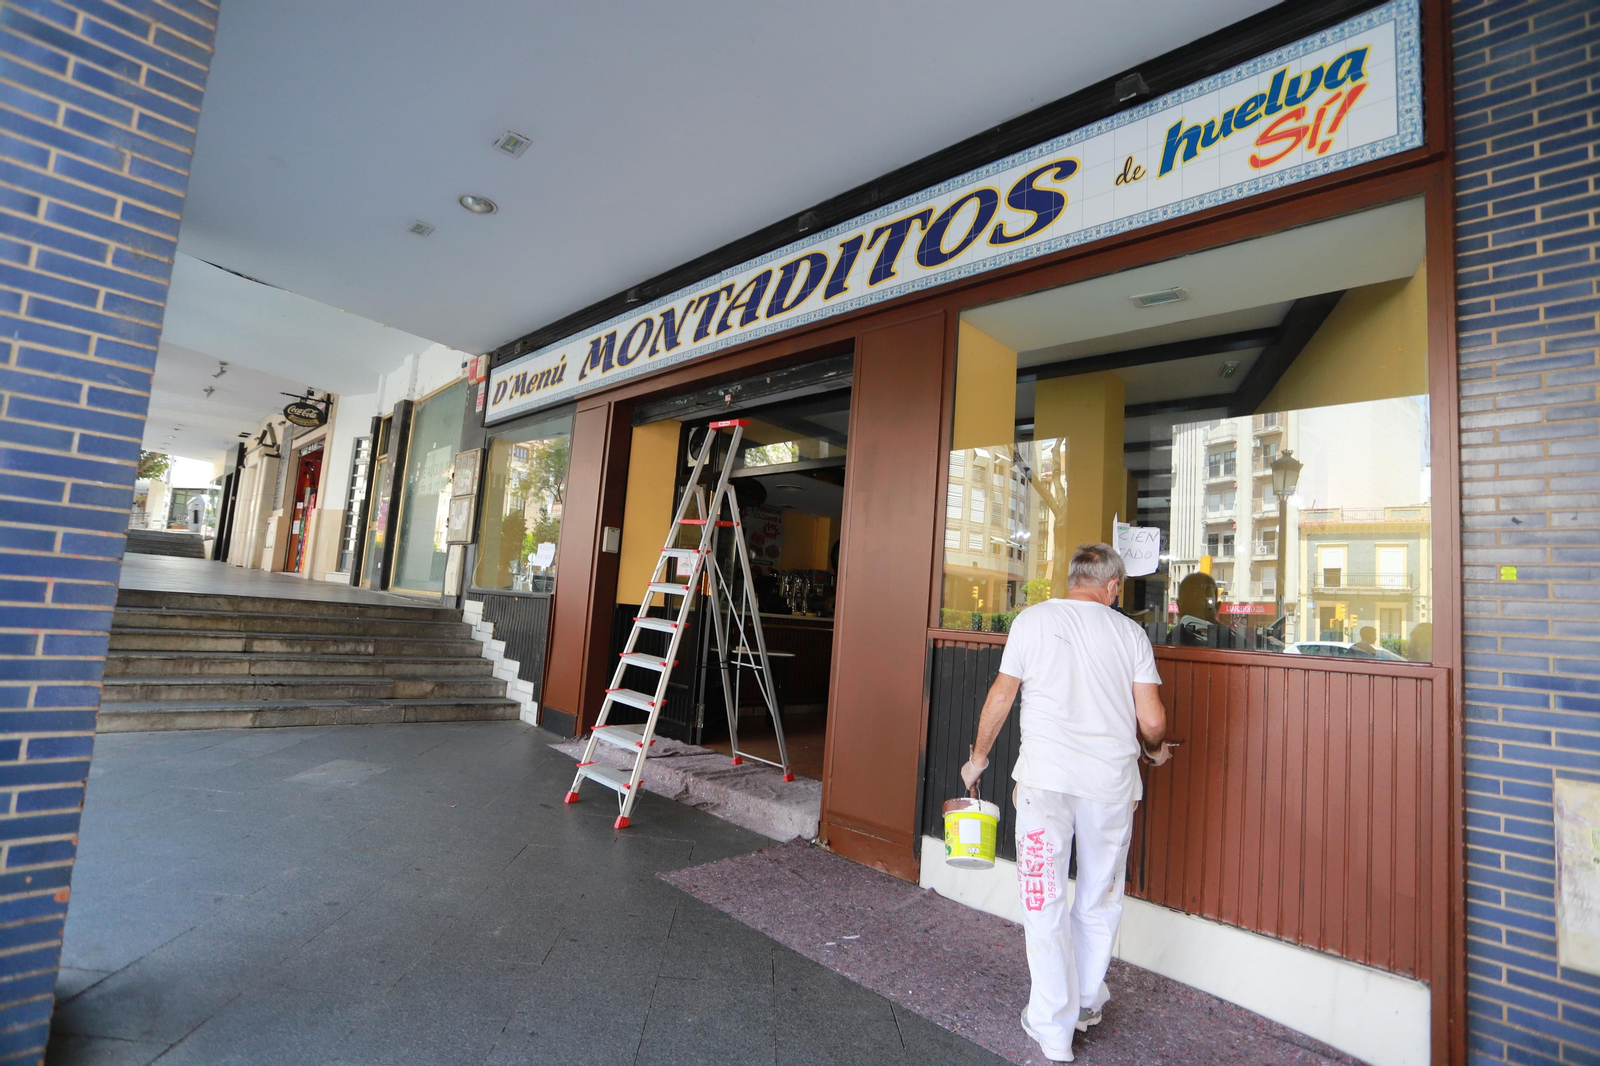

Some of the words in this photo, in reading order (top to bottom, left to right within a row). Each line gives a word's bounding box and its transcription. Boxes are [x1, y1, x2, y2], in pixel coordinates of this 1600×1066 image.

[578, 157, 1081, 383] MONTADITOS
[1115, 155, 1148, 188] de
[1156, 44, 1372, 180] huelva
[1046, 841, 1055, 855] 47
[1045, 856, 1055, 868] 40
[1046, 869, 1056, 881] 22
[1048, 881, 1057, 899] 959
